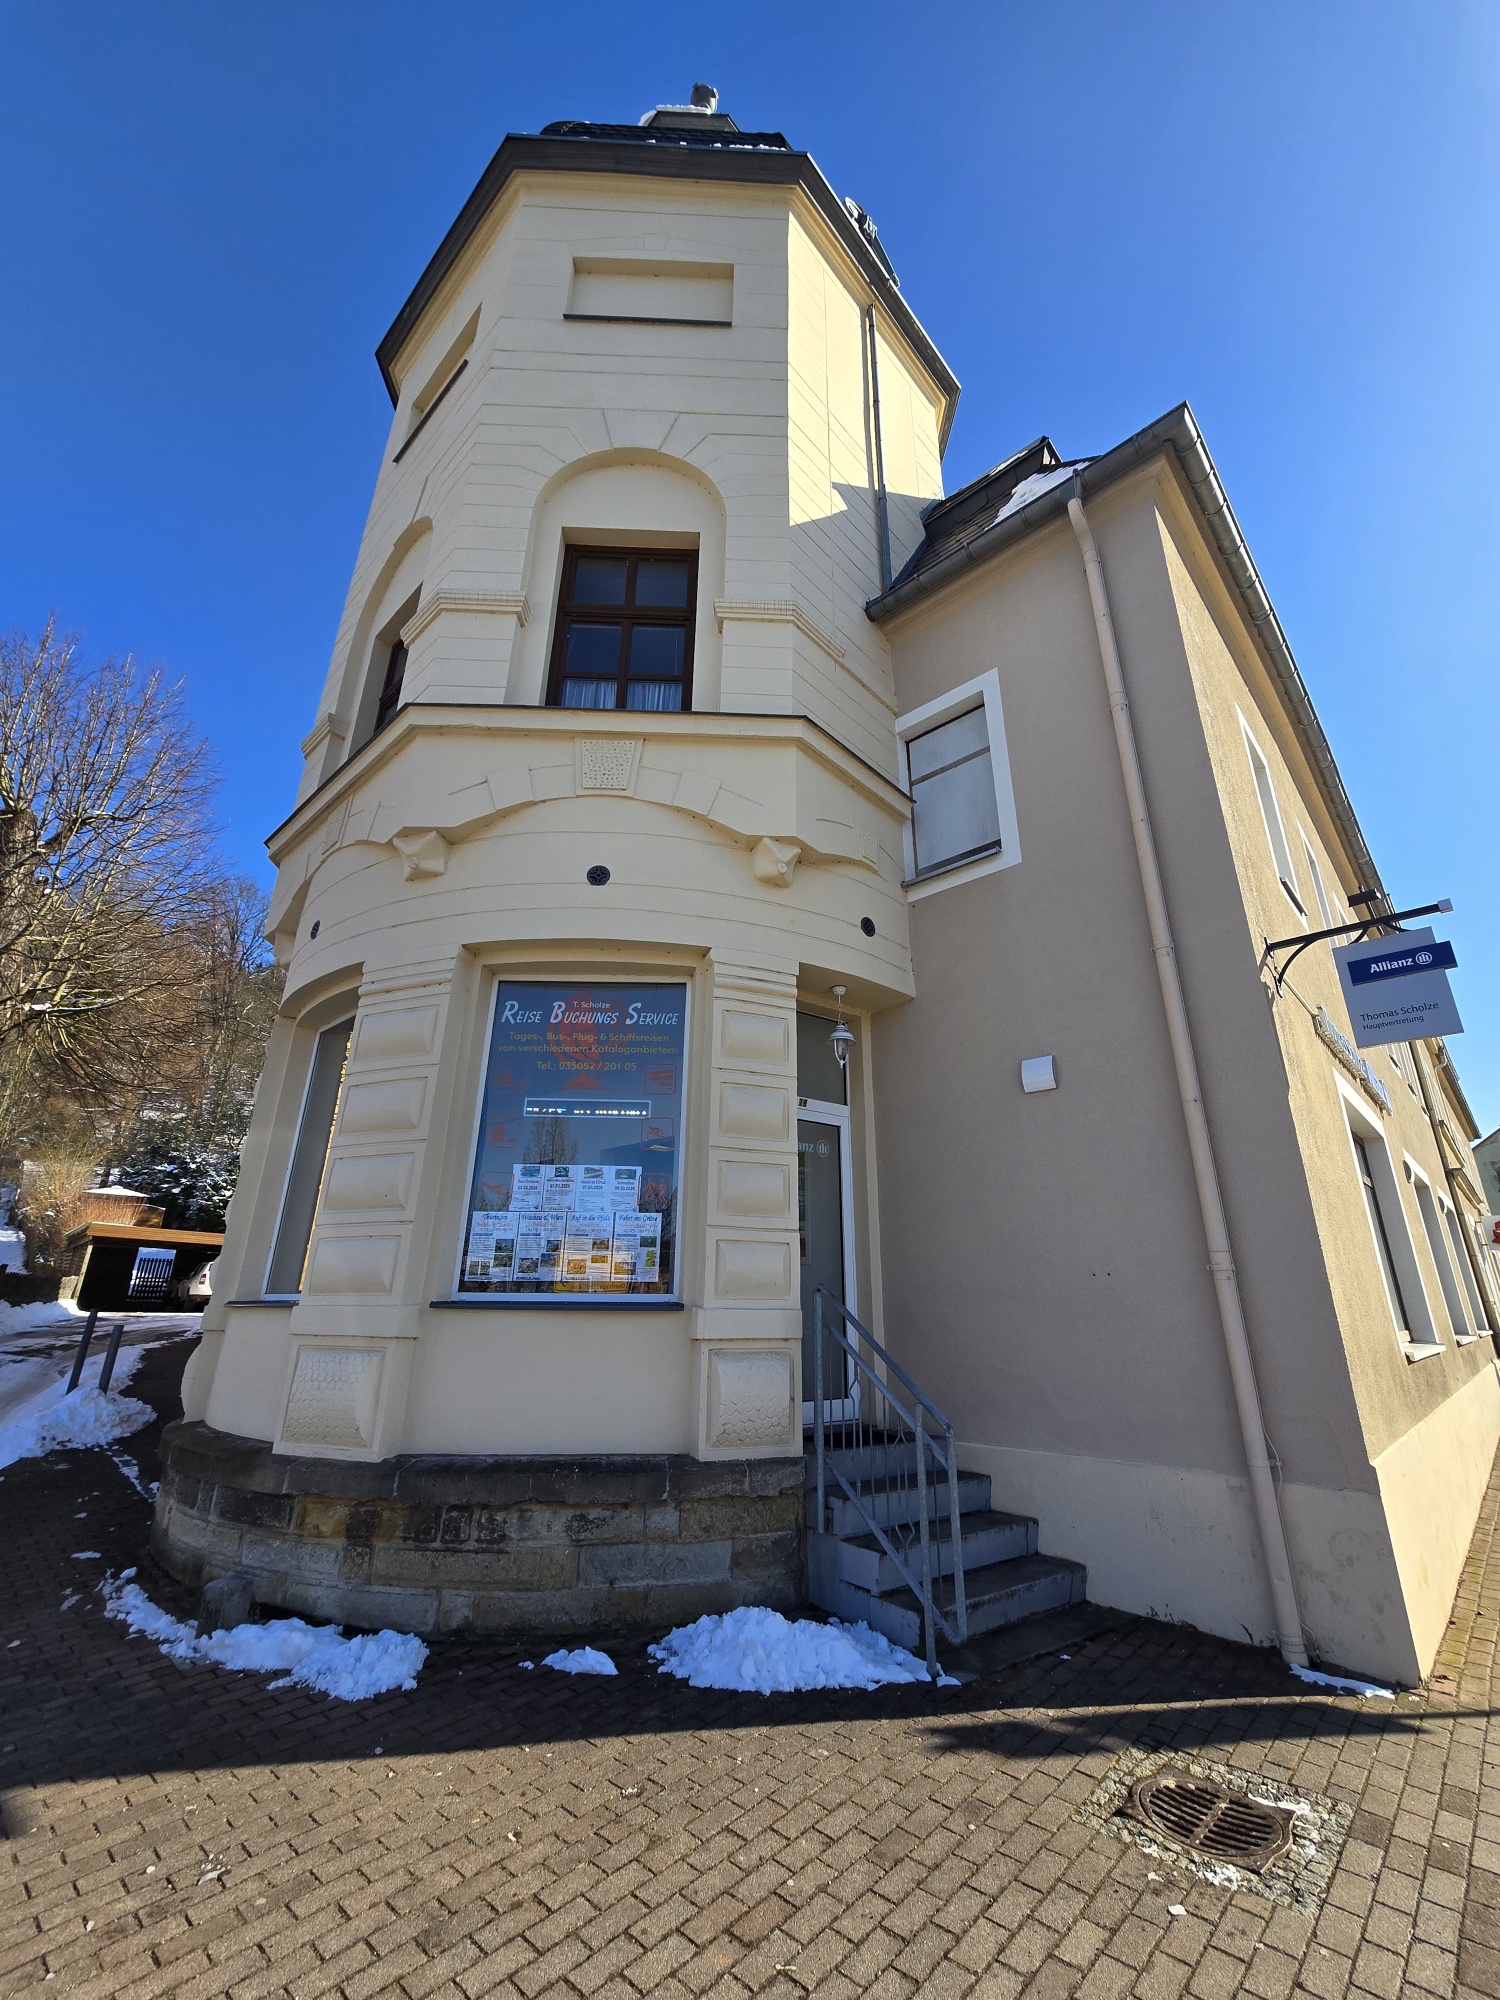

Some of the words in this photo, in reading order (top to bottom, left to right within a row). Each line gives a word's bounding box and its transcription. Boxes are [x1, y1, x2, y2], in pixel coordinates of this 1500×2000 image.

[1370, 958, 1414, 973] Allianz
[581, 1001, 610, 1009] Scholze
[501, 1000, 543, 1024] REISE
[550, 1001, 619, 1024] BUCHUNGS
[626, 1002, 679, 1025] SERVICE
[1360, 1010, 1399, 1021] Thomas
[1400, 1003, 1439, 1015] Scholze
[1363, 1016, 1424, 1030] Hauptvertretung
[509, 1032, 543, 1043] Tages-,
[547, 1032, 570, 1042] Bus-,
[573, 1032, 598, 1042] Flug-
[609, 1033, 669, 1041] Schiffsreisen
[519, 1044, 589, 1053] verschiedenen
[592, 1045, 678, 1054] Kataloganbietern
[537, 1061, 556, 1070] Tel.:
[559, 1062, 595, 1070] 035052
[604, 1062, 620, 1070] 201
